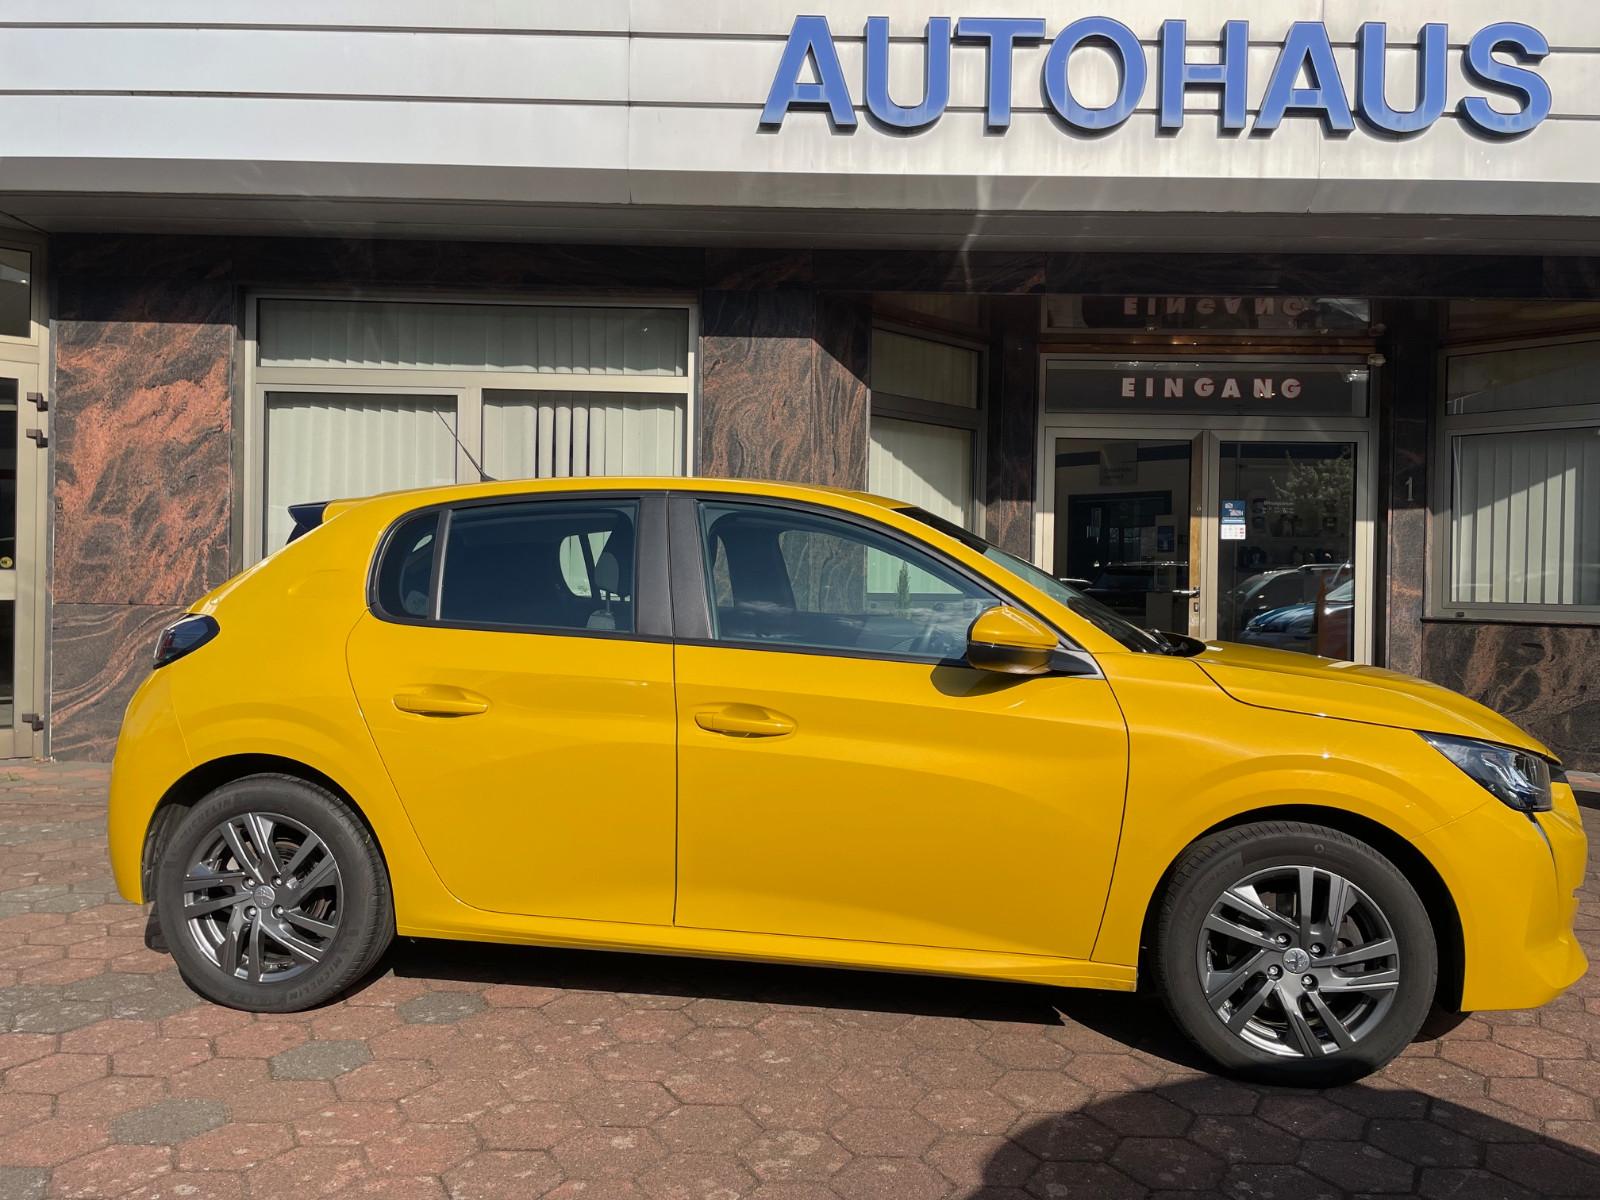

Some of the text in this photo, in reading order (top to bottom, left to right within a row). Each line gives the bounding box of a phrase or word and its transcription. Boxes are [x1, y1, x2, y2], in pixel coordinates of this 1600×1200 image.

[758, 14, 1554, 136] AUTOHAUS
[1121, 377, 1302, 399] EINGANG
[1405, 476, 1415, 502] 1
